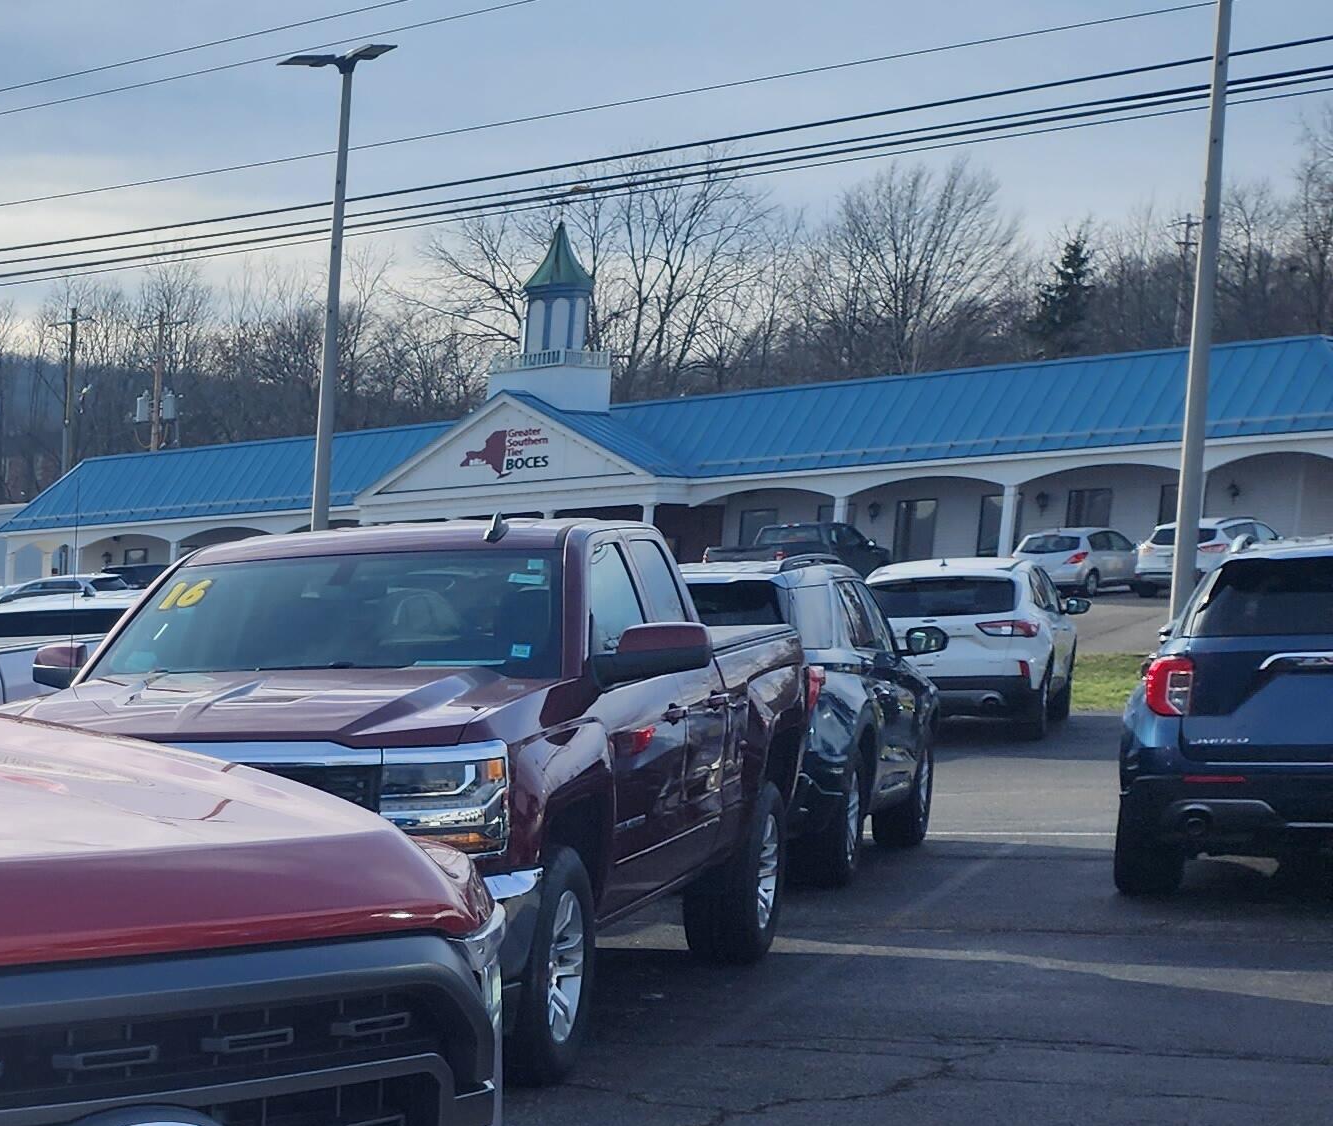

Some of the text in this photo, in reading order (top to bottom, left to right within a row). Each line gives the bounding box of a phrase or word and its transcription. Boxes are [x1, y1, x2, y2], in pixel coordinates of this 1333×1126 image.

[507, 428, 541, 438] Greater
[507, 437, 549, 447] Southern
[507, 448, 524, 456] Tier
[505, 456, 549, 470] BOCES
[158, 579, 213, 611] 16
